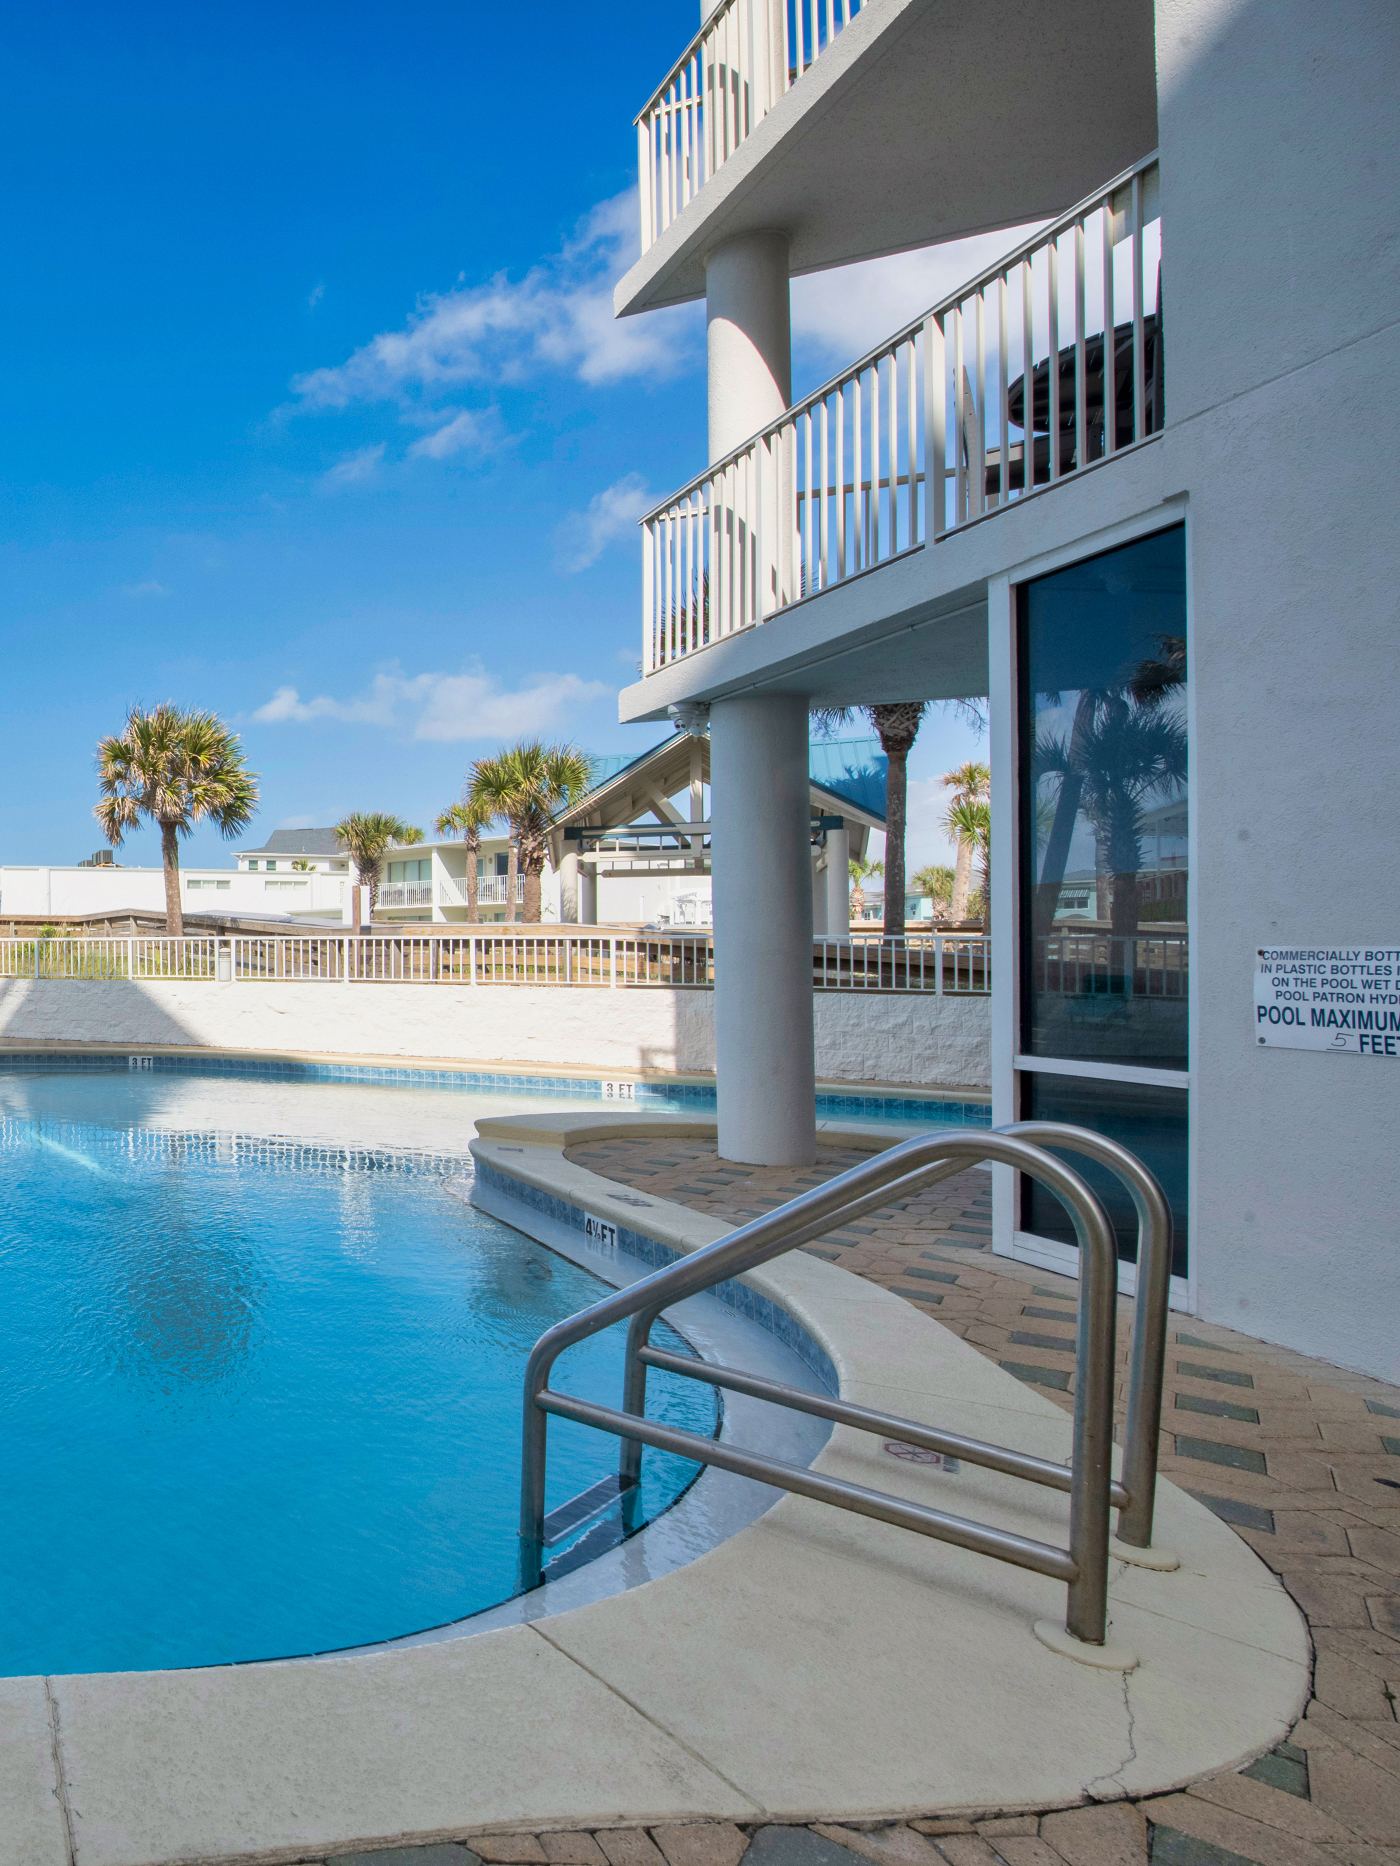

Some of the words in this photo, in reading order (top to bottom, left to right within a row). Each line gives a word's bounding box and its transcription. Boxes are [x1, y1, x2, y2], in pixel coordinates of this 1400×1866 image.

[1262, 950, 1361, 962] COMMERCIALLY
[1260, 963, 1272, 974] IN
[1275, 964, 1326, 975] PLASTIC
[1330, 964, 1392, 976] BOTTLES
[1271, 976, 1290, 988] ON
[1292, 977, 1317, 988] THE
[1321, 978, 1357, 990] POOL
[1361, 979, 1391, 991] WET
[1275, 990, 1309, 1002] POOL
[1312, 991, 1365, 1004] PATRON
[1369, 993, 1400, 1006] HYD
[1257, 1004, 1306, 1026] POOL
[1310, 1007, 1400, 1032] MAXIMUM
[1330, 1032, 1354, 1047] 5
[141, 1057, 152, 1066] FT
[606, 1082, 614, 1093] 3
[618, 1083, 633, 1093] FT
